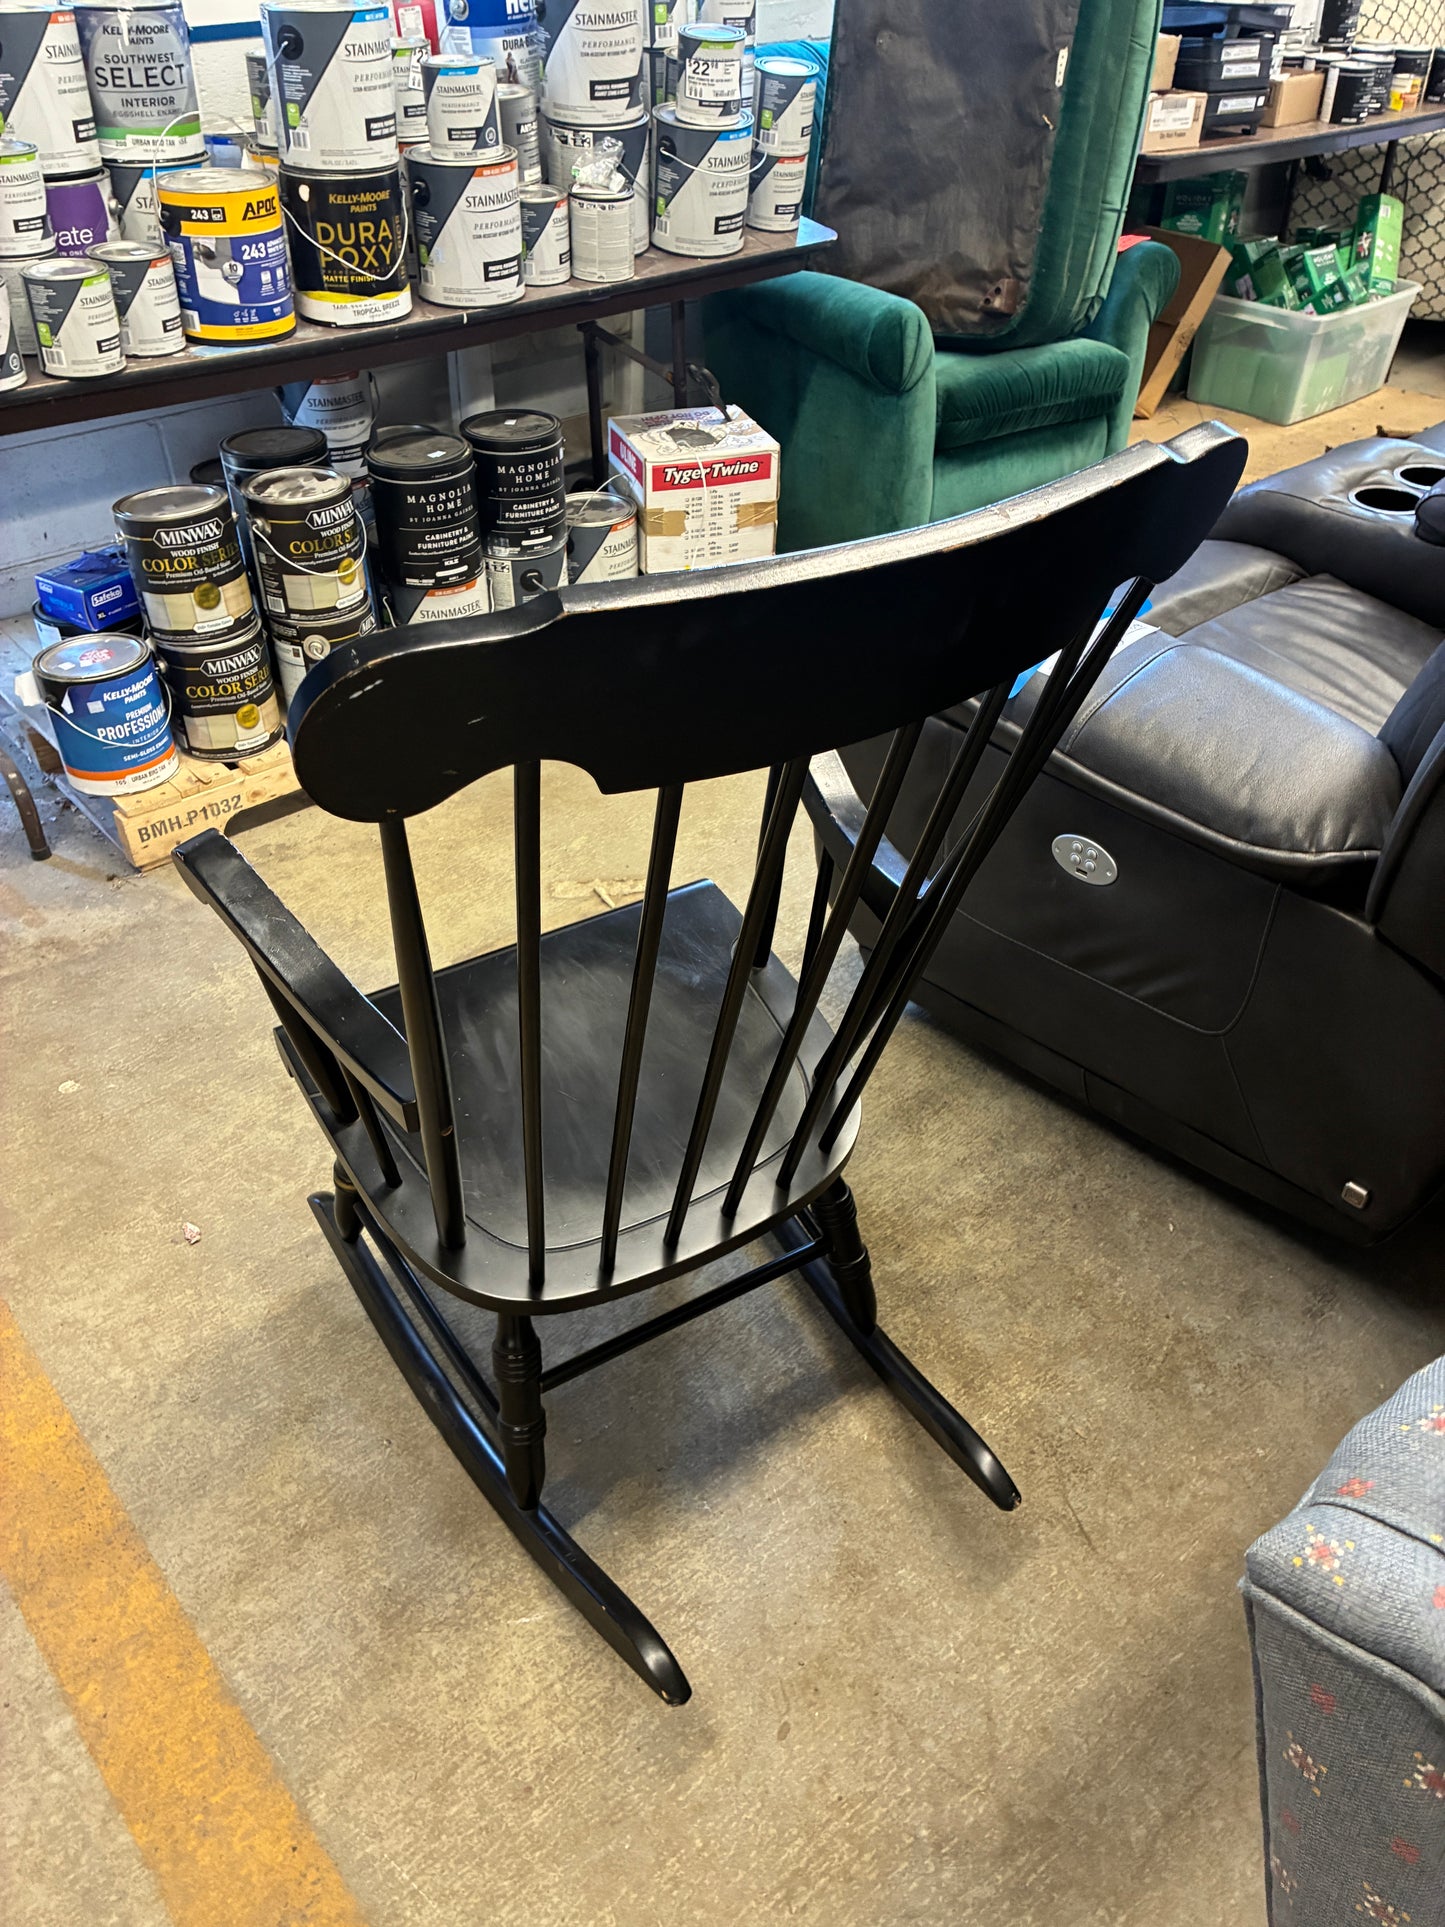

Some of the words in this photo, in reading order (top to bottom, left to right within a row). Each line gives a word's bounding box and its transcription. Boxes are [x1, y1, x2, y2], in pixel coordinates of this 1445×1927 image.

[575, 10, 638, 26] STAINMASTER
[102, 25, 169, 35] KELY-MOORE
[127, 37, 154, 45] AINTS
[104, 52, 174, 64] SOUTHWEST
[95, 64, 184, 88] SELECT
[436, 84, 482, 94] STAINMASTER
[121, 96, 176, 107] INTERIOR
[329, 190, 391, 204] KELLY-MOORE
[190, 209, 209, 220] 243
[242, 196, 277, 221] APOC
[350, 203, 377, 213] PAINTS
[316, 219, 392, 245] DURA
[241, 243, 267, 260] 243
[320, 243, 393, 268] POXY
[323, 274, 348, 283] MATTE
[353, 306, 381, 317] TROPICAL
[497, 457, 560, 474] MAGNOLIA
[664, 464, 712, 486] Tyger
[711, 459, 761, 479] Twine
[515, 471, 550, 484] HOME
[407, 483, 472, 504] MAGNOLIA
[426, 498, 462, 513] HOME
[505, 509, 545, 519] FURNITURE
[545, 502, 560, 514] PAINT
[512, 500, 549, 511] CABINETRY
[422, 513, 452, 523] JOANNA
[160, 521, 220, 545] MINWAX
[320, 526, 341, 538] WOOD
[425, 527, 464, 542] CABINETRY
[290, 535, 344, 555] COLOR
[418, 538, 458, 550] FURNITURE
[459, 531, 474, 543] PAINT
[170, 548, 196, 558] WOOD
[197, 542, 219, 555] FINISH
[142, 557, 200, 572] COLOR
[420, 599, 481, 619] STAINMASTER
[207, 648, 259, 674] MINWAX
[216, 675, 240, 685] WOOD
[240, 665, 259, 680] FINISH
[103, 672, 154, 702] KELLY-MOORE
[186, 682, 243, 699] COLOR
[124, 689, 147, 704] PAINTS
[211, 694, 237, 702] Premium
[125, 702, 153, 721] PREMIUM
[123, 744, 156, 762] SEMI-GLOSS
[131, 773, 148, 783] URBAN
